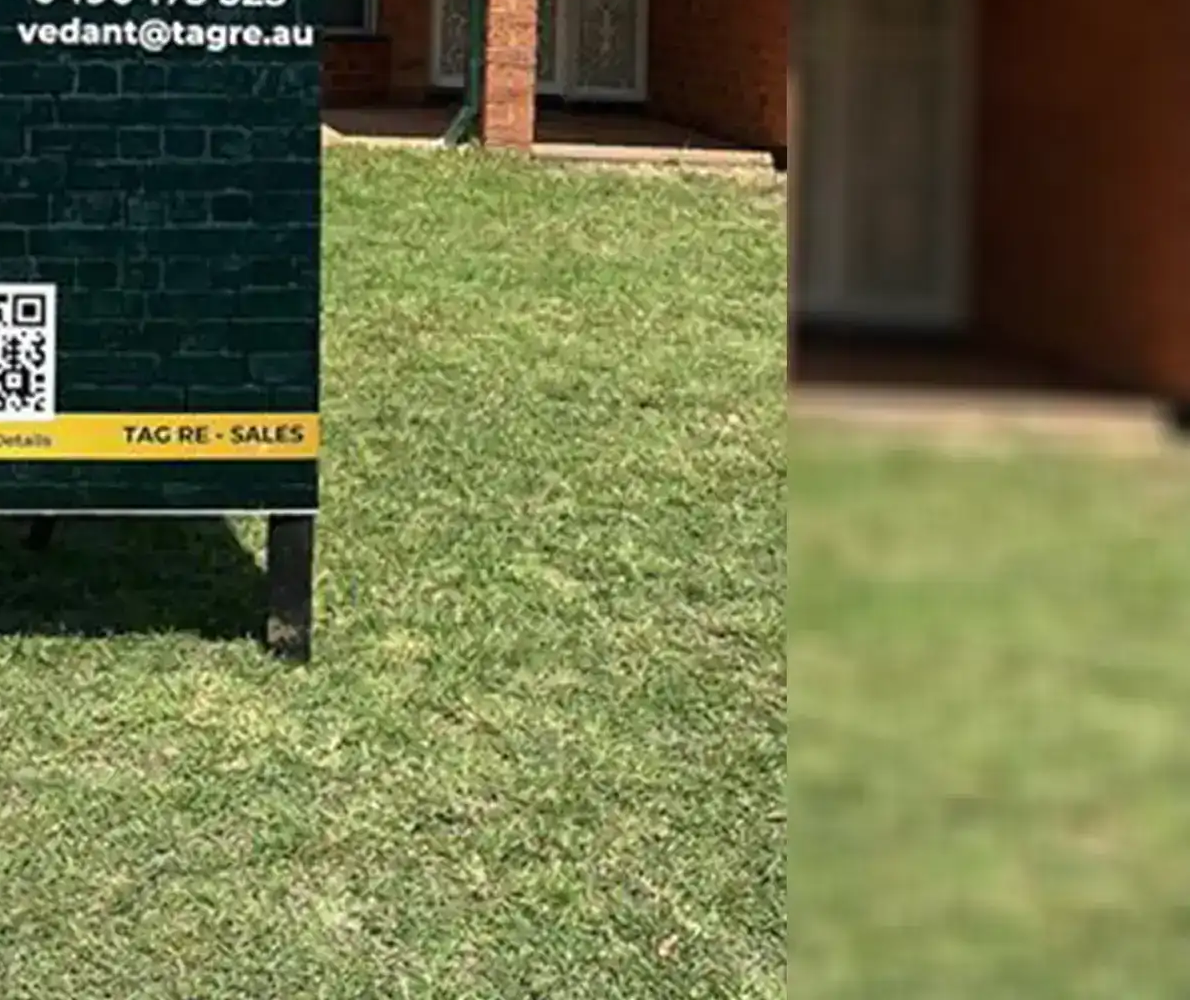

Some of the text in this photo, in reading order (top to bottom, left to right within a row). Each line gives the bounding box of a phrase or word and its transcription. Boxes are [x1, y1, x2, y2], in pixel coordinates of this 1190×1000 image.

[17, 17, 314, 51] vedant@tagre.au
[123, 425, 175, 444] TAG
[178, 426, 209, 445] RE
[230, 425, 305, 445] SALES
